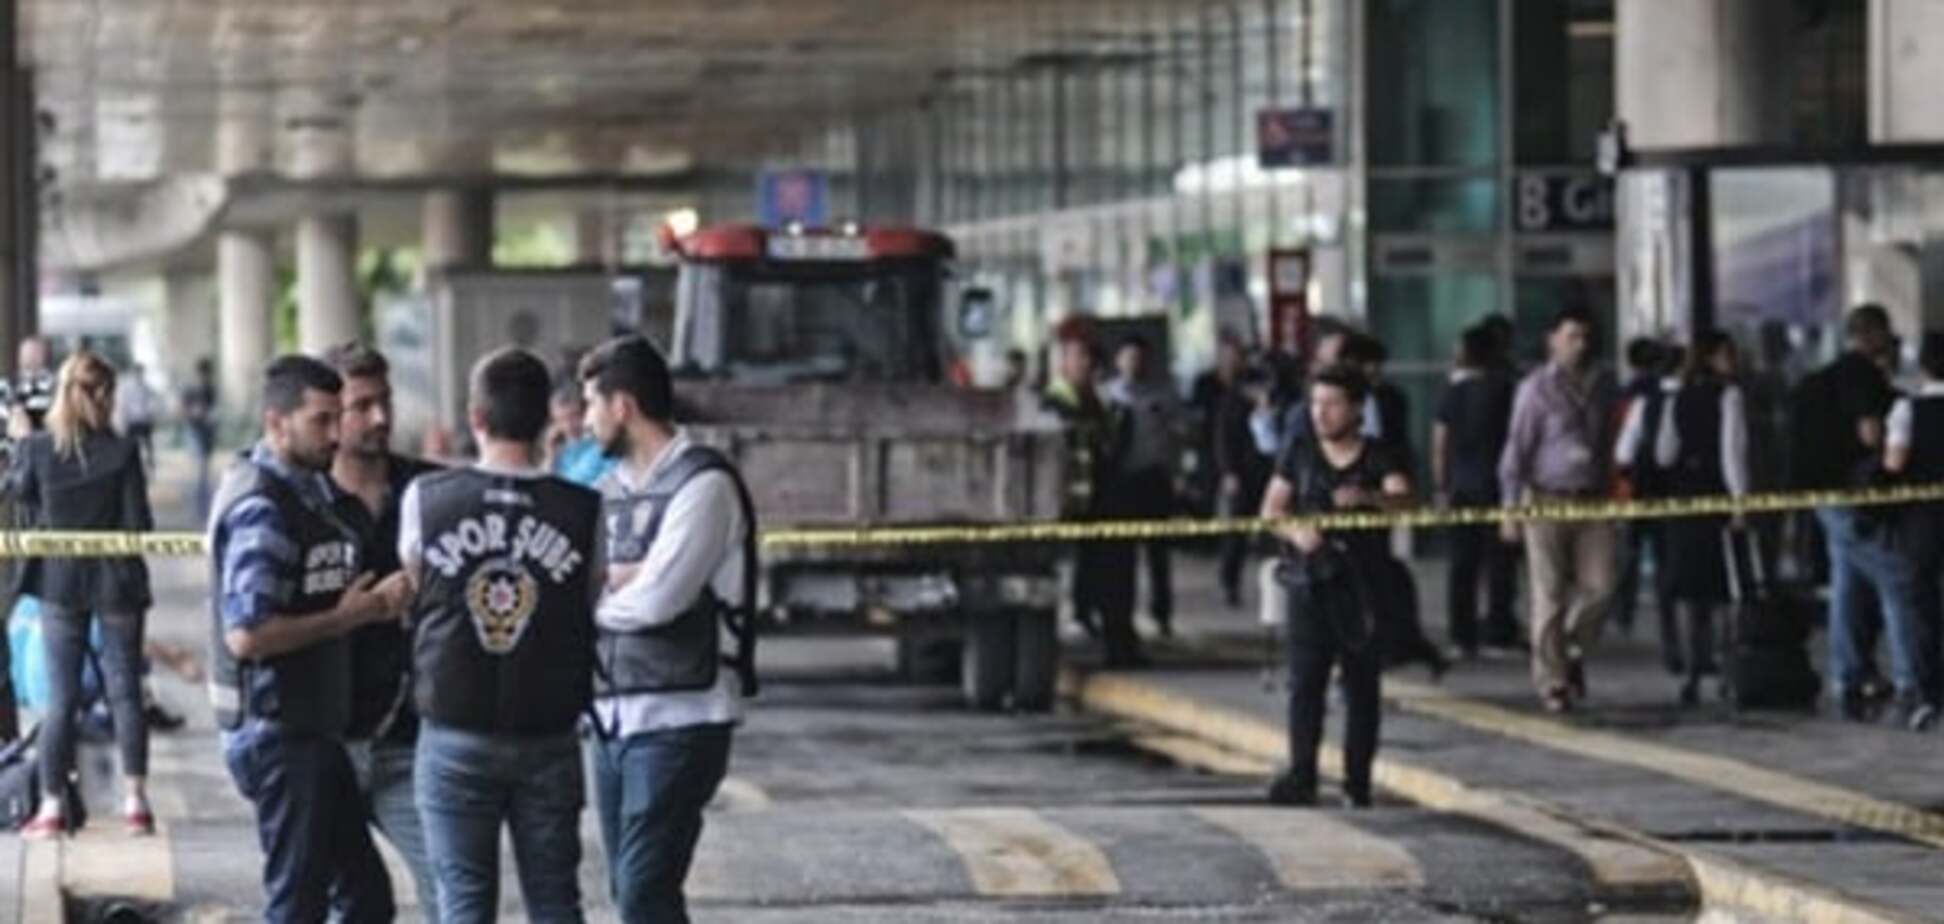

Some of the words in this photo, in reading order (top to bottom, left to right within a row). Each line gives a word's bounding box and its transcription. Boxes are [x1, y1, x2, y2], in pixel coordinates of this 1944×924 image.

[1519, 176, 1549, 228] B
[425, 513, 508, 578] SPOR
[511, 515, 584, 584] ŞUBE
